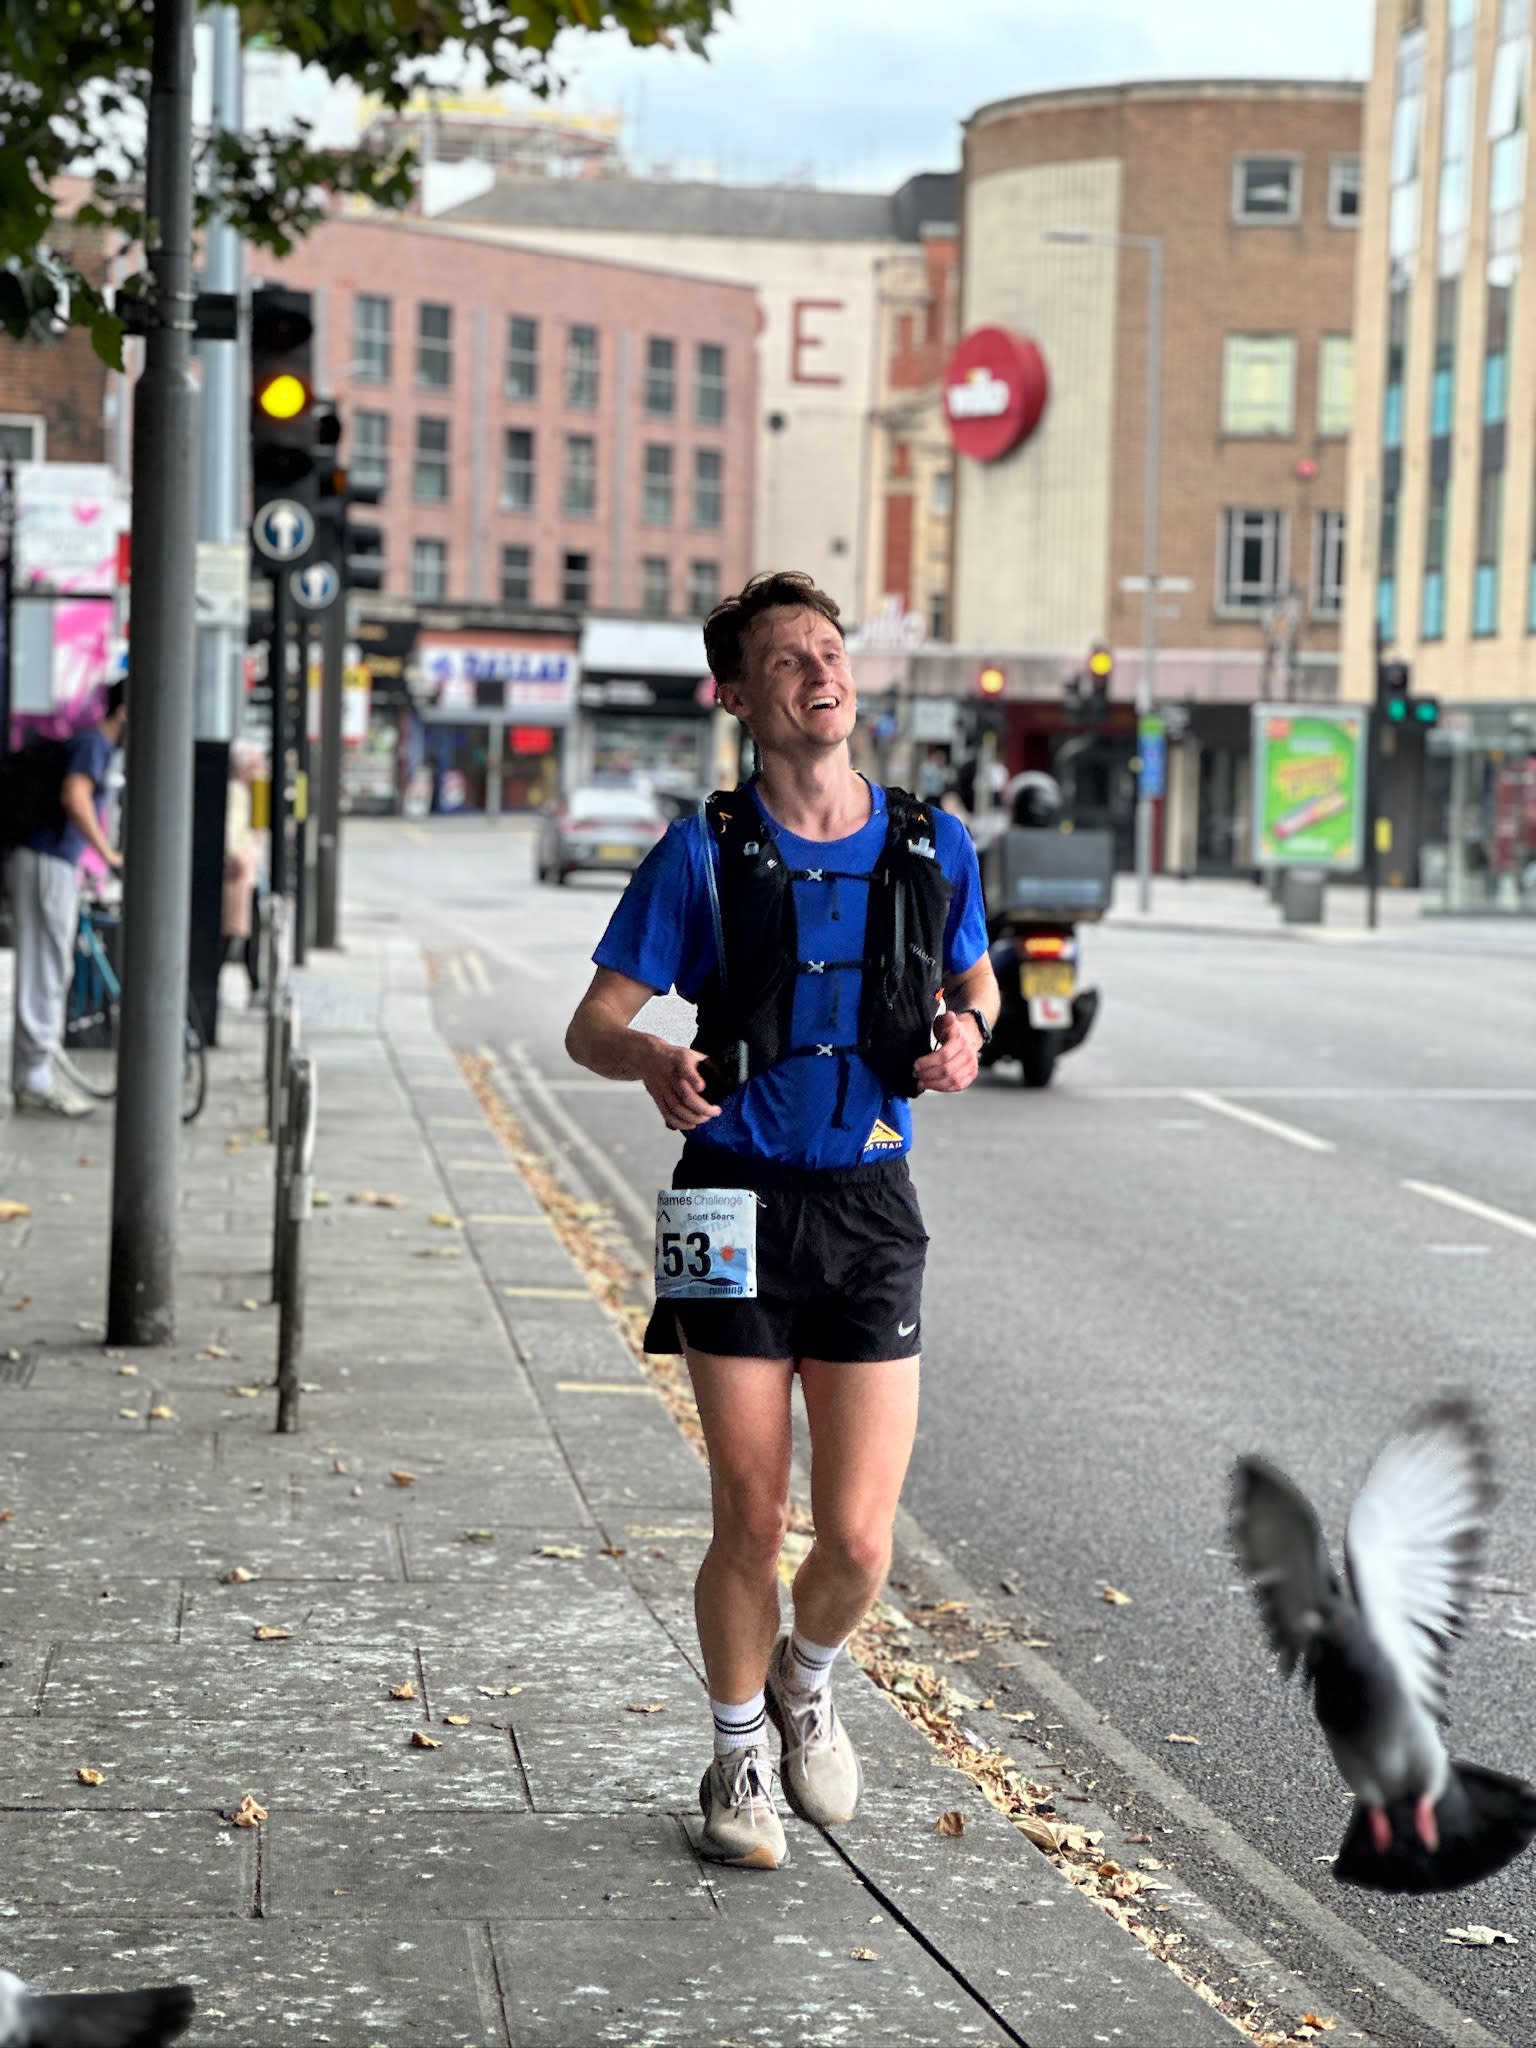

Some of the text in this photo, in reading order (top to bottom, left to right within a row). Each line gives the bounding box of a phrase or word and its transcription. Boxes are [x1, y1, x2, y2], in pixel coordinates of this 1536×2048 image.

[694, 1194, 743, 1209] Challenge
[687, 1212, 735, 1221] Scott Sears
